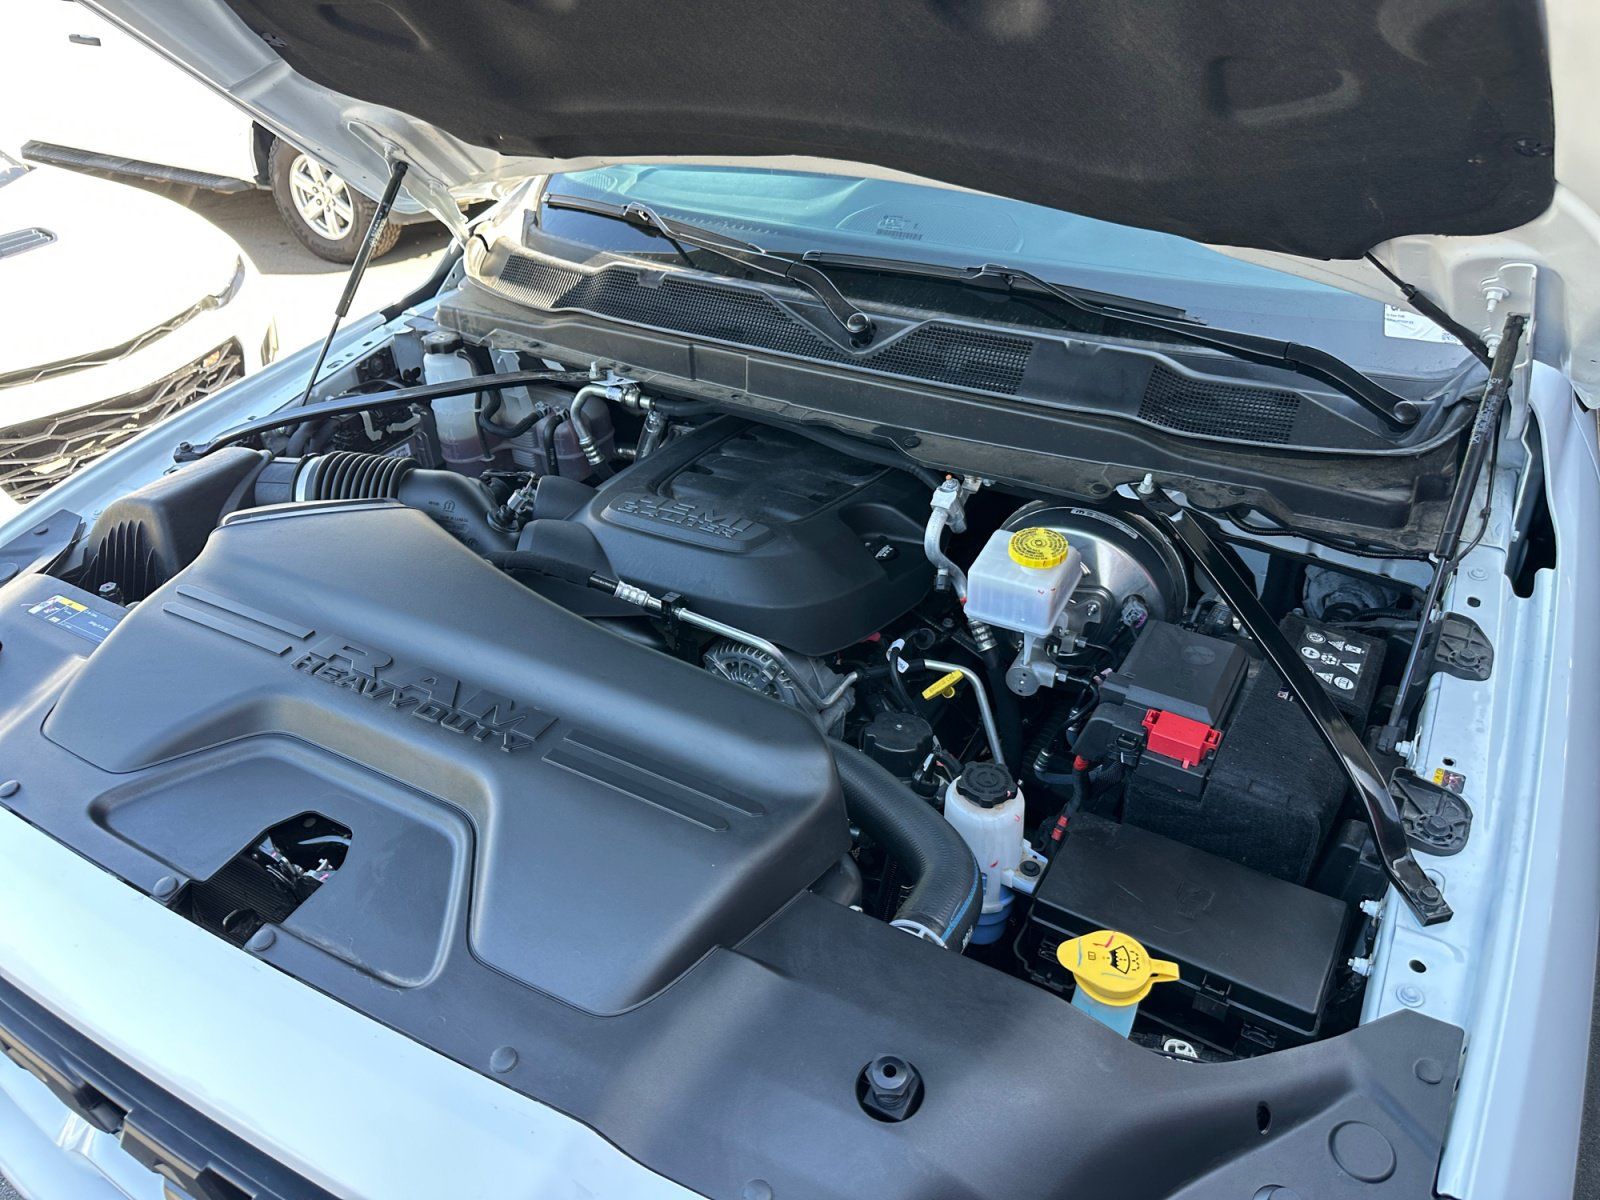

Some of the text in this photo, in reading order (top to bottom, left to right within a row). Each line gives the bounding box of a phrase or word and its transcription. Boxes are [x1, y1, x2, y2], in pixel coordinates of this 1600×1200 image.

[290, 655, 535, 752] HEAVY DUTY
[309, 633, 560, 741] RAM
